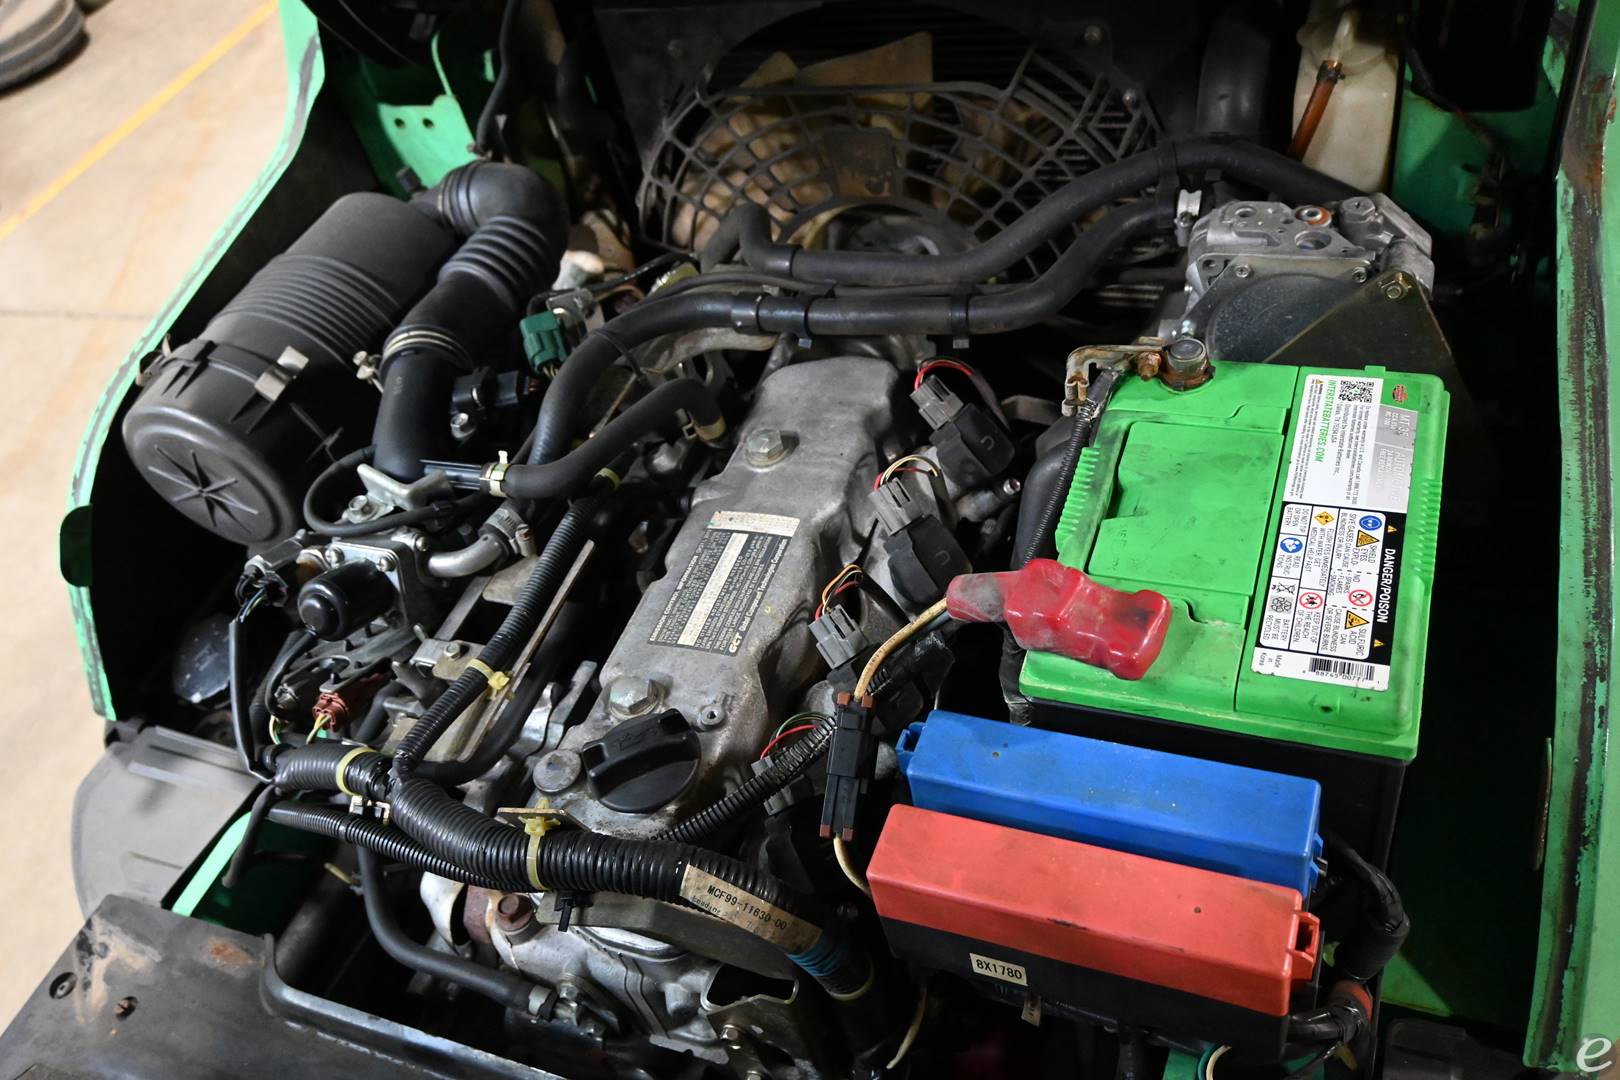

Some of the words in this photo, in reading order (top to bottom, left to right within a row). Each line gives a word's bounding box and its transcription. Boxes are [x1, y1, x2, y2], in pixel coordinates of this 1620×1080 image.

[1314, 379, 1337, 462] INTERSTATEBATTERIES.COM
[1338, 512, 1348, 536] BLINDNESS
[1345, 525, 1354, 542] GASES
[1308, 526, 1318, 546] MEDICAL
[1344, 542, 1352, 552] CAN
[1359, 548, 1367, 561] EYES
[1367, 545, 1377, 563] SHIELD
[1341, 552, 1350, 567] CAUSE
[1318, 555, 1329, 586] IMMEDIATELY
[727, 632, 744, 653] GCT
[757, 563, 777, 590] Technologies
[770, 538, 788, 563] Corporation
[1376, 548, 1395, 623] DANGER/POISON
[649, 615, 667, 640] EMISSION
[663, 590, 680, 614] CONTROL
[676, 555, 698, 589] INFORMATION
[1322, 614, 1332, 635] SEVERE
[1333, 608, 1342, 624] CAUSE
[1280, 619, 1289, 641] BATTERY
[1302, 621, 1311, 638] REACH
[1329, 625, 1340, 652] BLINDNESS
[1348, 630, 1357, 644] ACID
[1356, 627, 1366, 656] SULFURIC
[1258, 652, 1266, 665] Korea
[1274, 654, 1282, 668] Made
[707, 885, 788, 930] MCF99-11630-00
[976, 959, 1022, 979] 8X1780
